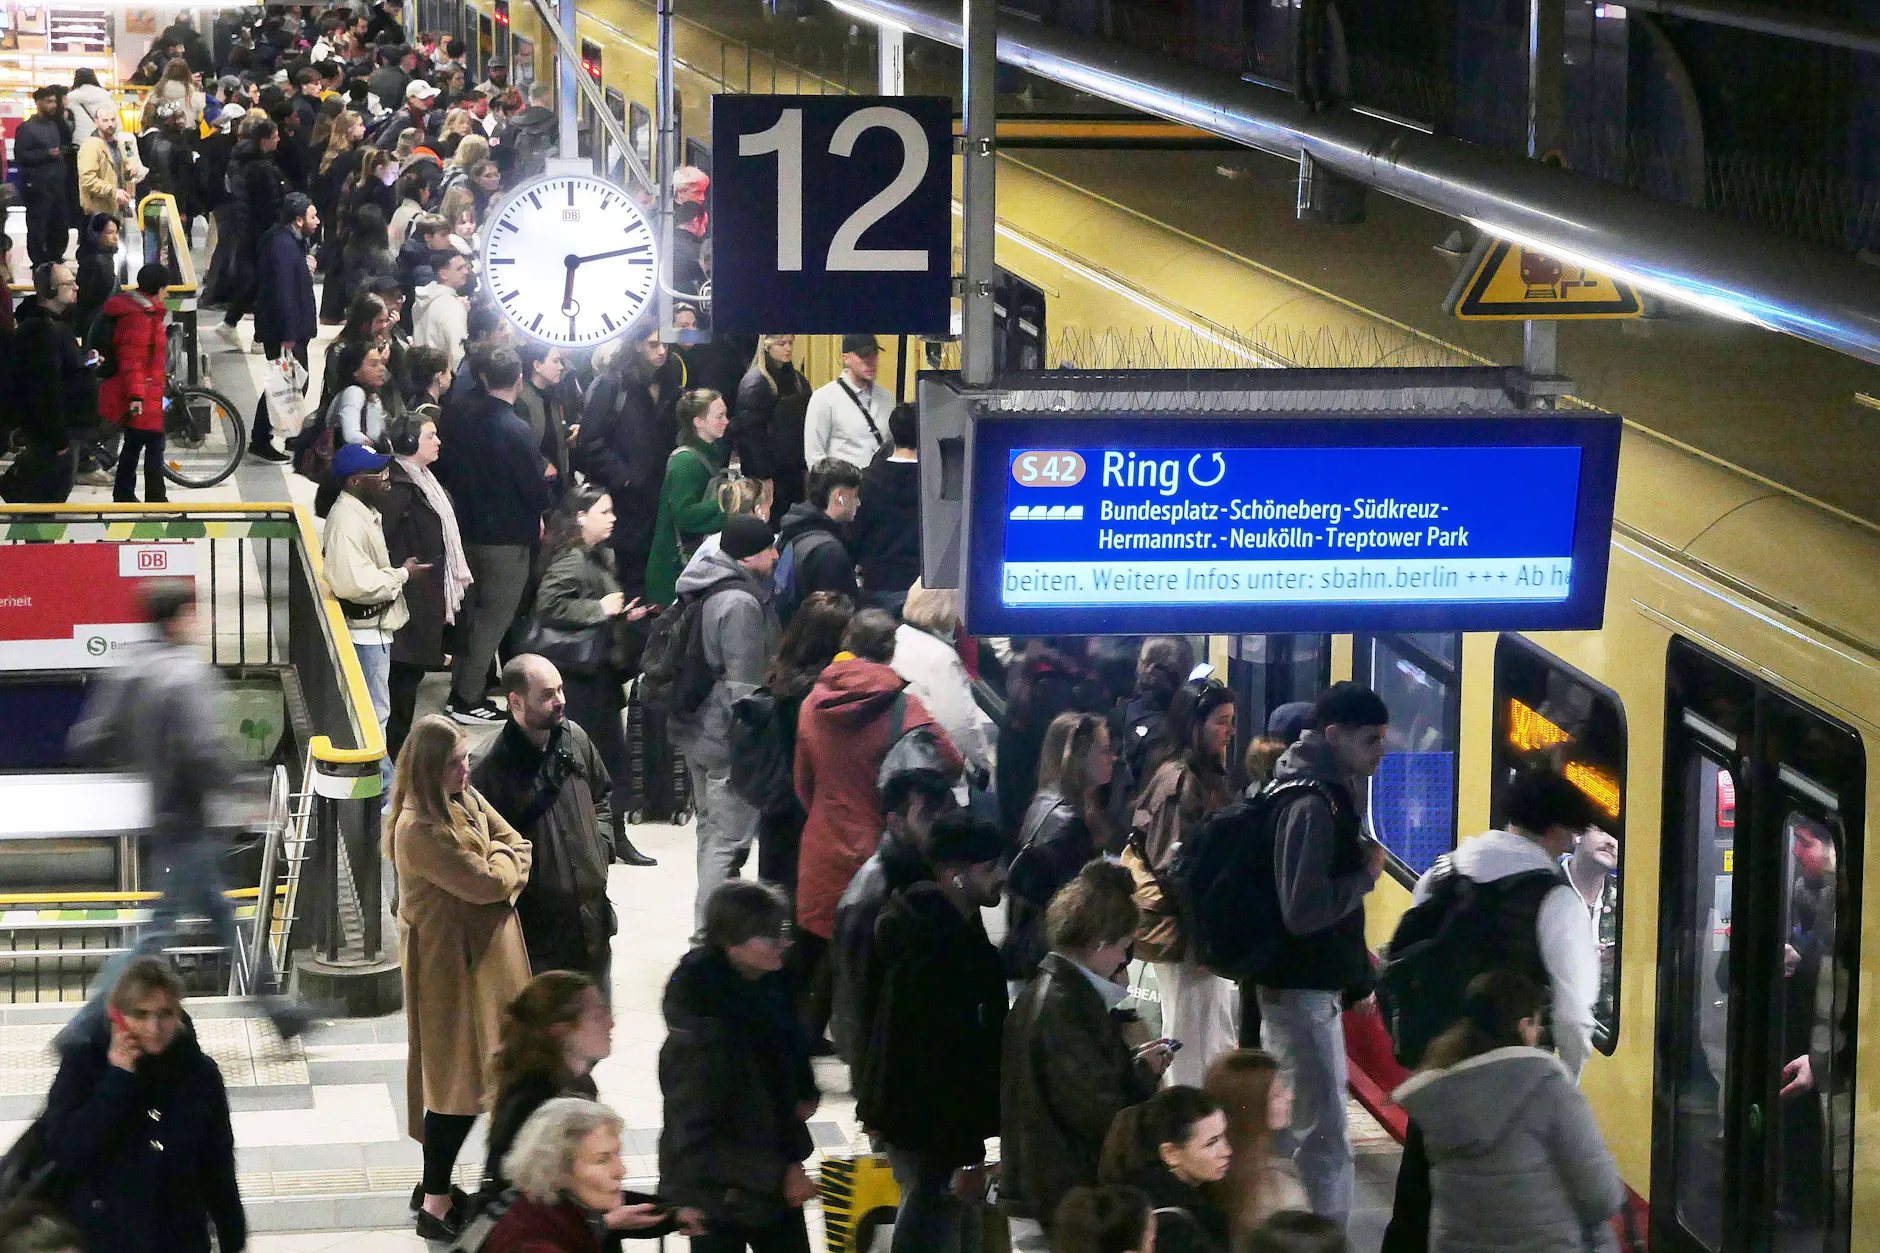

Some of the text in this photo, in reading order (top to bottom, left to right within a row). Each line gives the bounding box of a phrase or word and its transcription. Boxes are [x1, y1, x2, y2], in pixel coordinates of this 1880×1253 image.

[738, 106, 930, 272] 12
[563, 210, 579, 220] DB
[1102, 451, 1180, 496] Ring
[1427, 526, 1469, 547] Park
[140, 553, 164, 567] DB
[1005, 568, 1084, 592] beiten.
[1092, 568, 1179, 592] Weitere
[1185, 567, 1241, 592] Infos
[1247, 570, 1314, 592] unter:
[1320, 566, 1458, 590] sbahn.berlin
[1515, 564, 1544, 586] Ab
